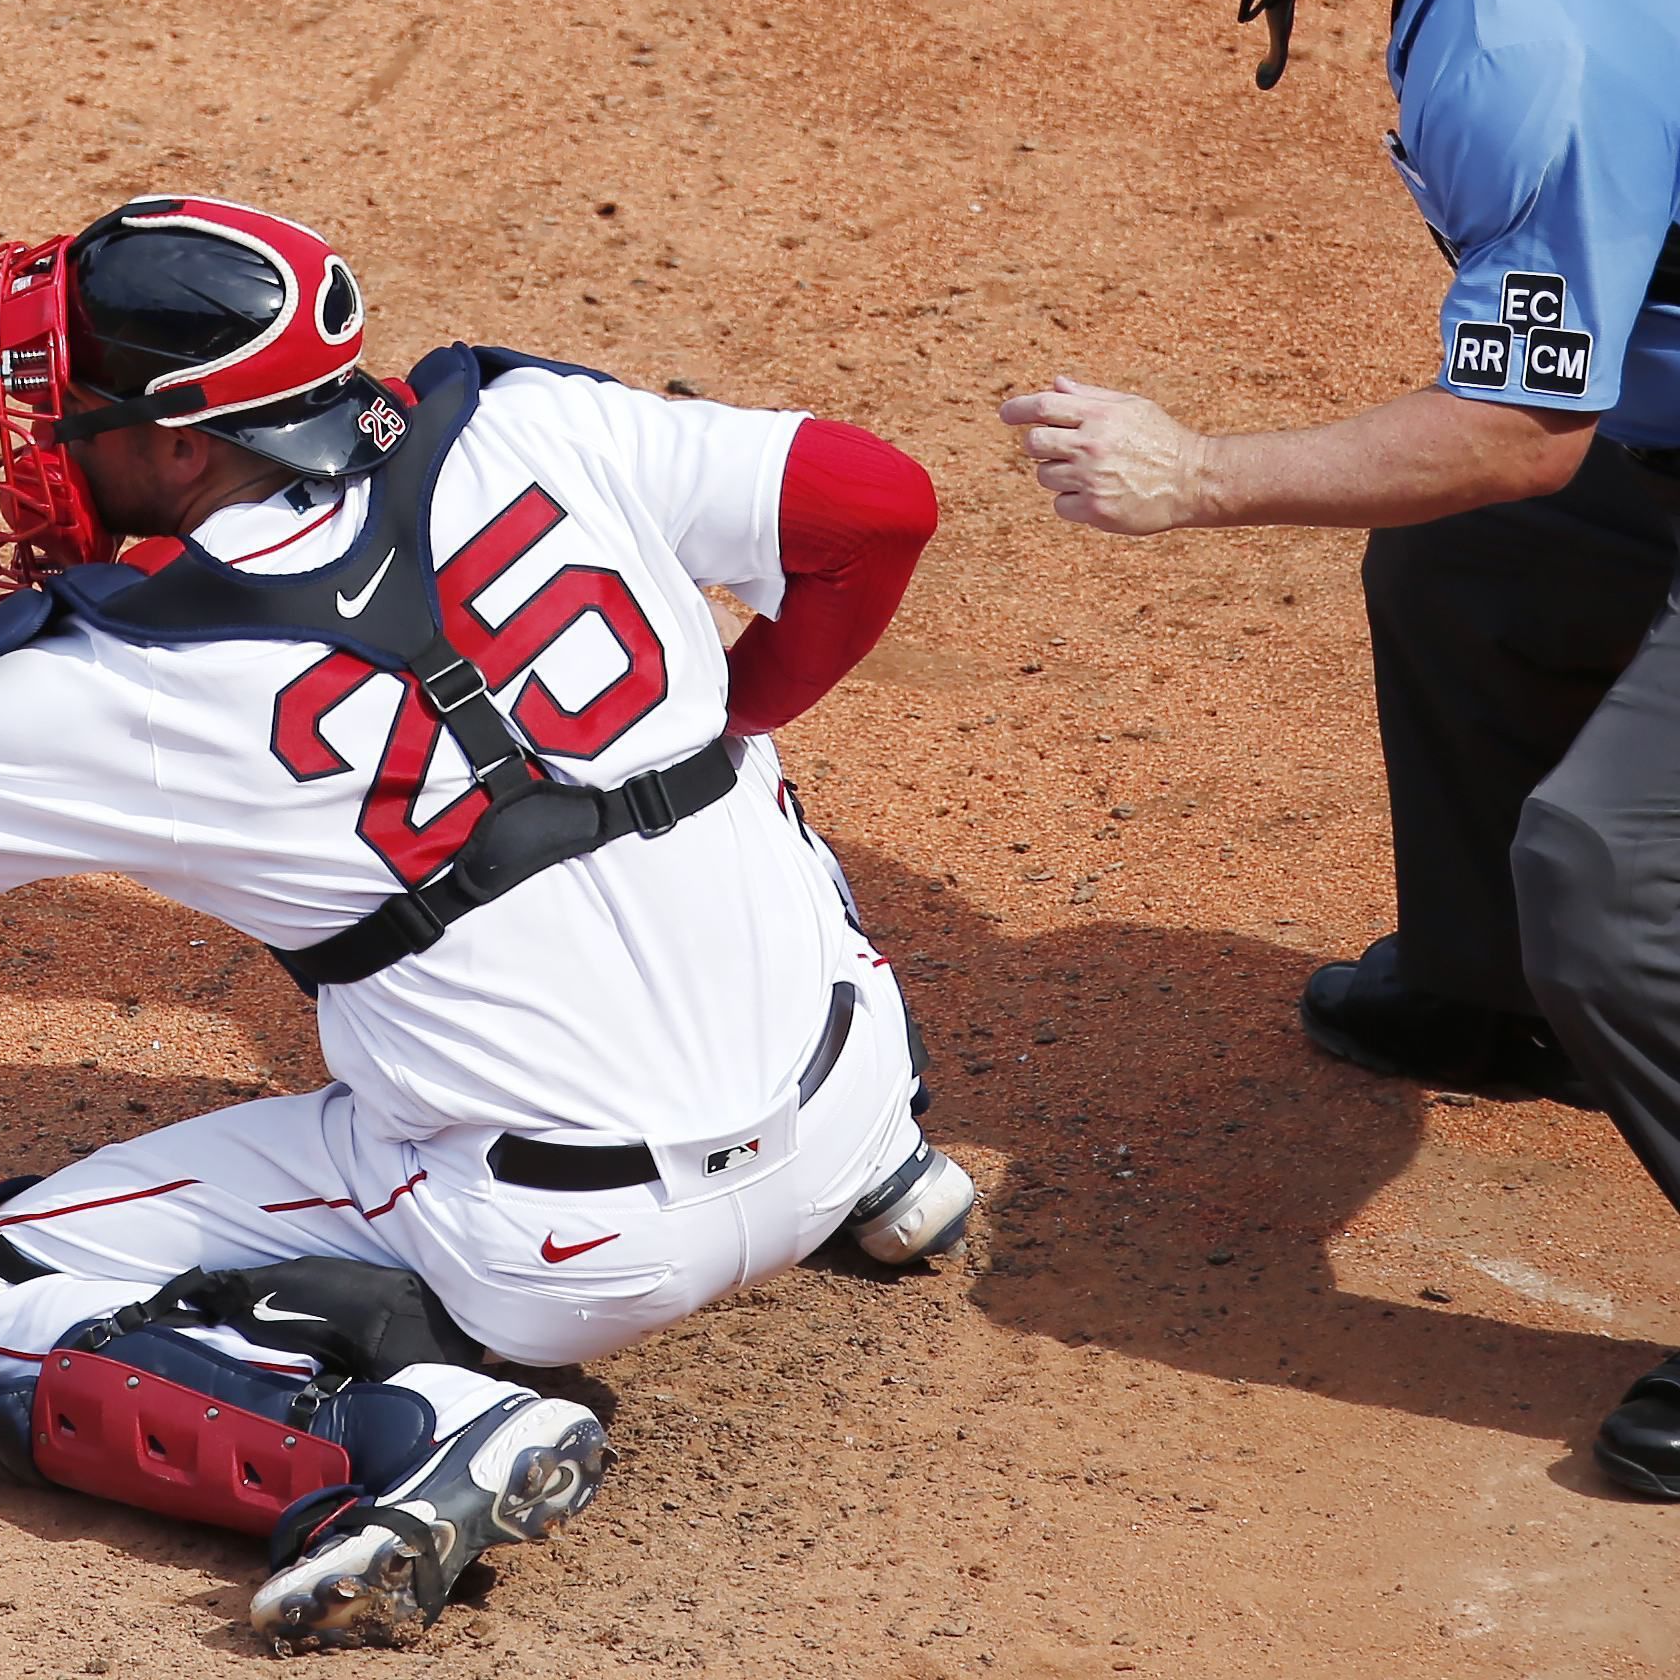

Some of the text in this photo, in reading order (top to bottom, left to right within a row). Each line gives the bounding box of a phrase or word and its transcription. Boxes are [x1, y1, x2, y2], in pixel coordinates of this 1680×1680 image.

[1505, 288, 1559, 323] EC
[1457, 337, 1504, 373] RR
[1531, 345, 1585, 380] CM
[358, 396, 406, 452] 25
[269, 481, 669, 887] 25
